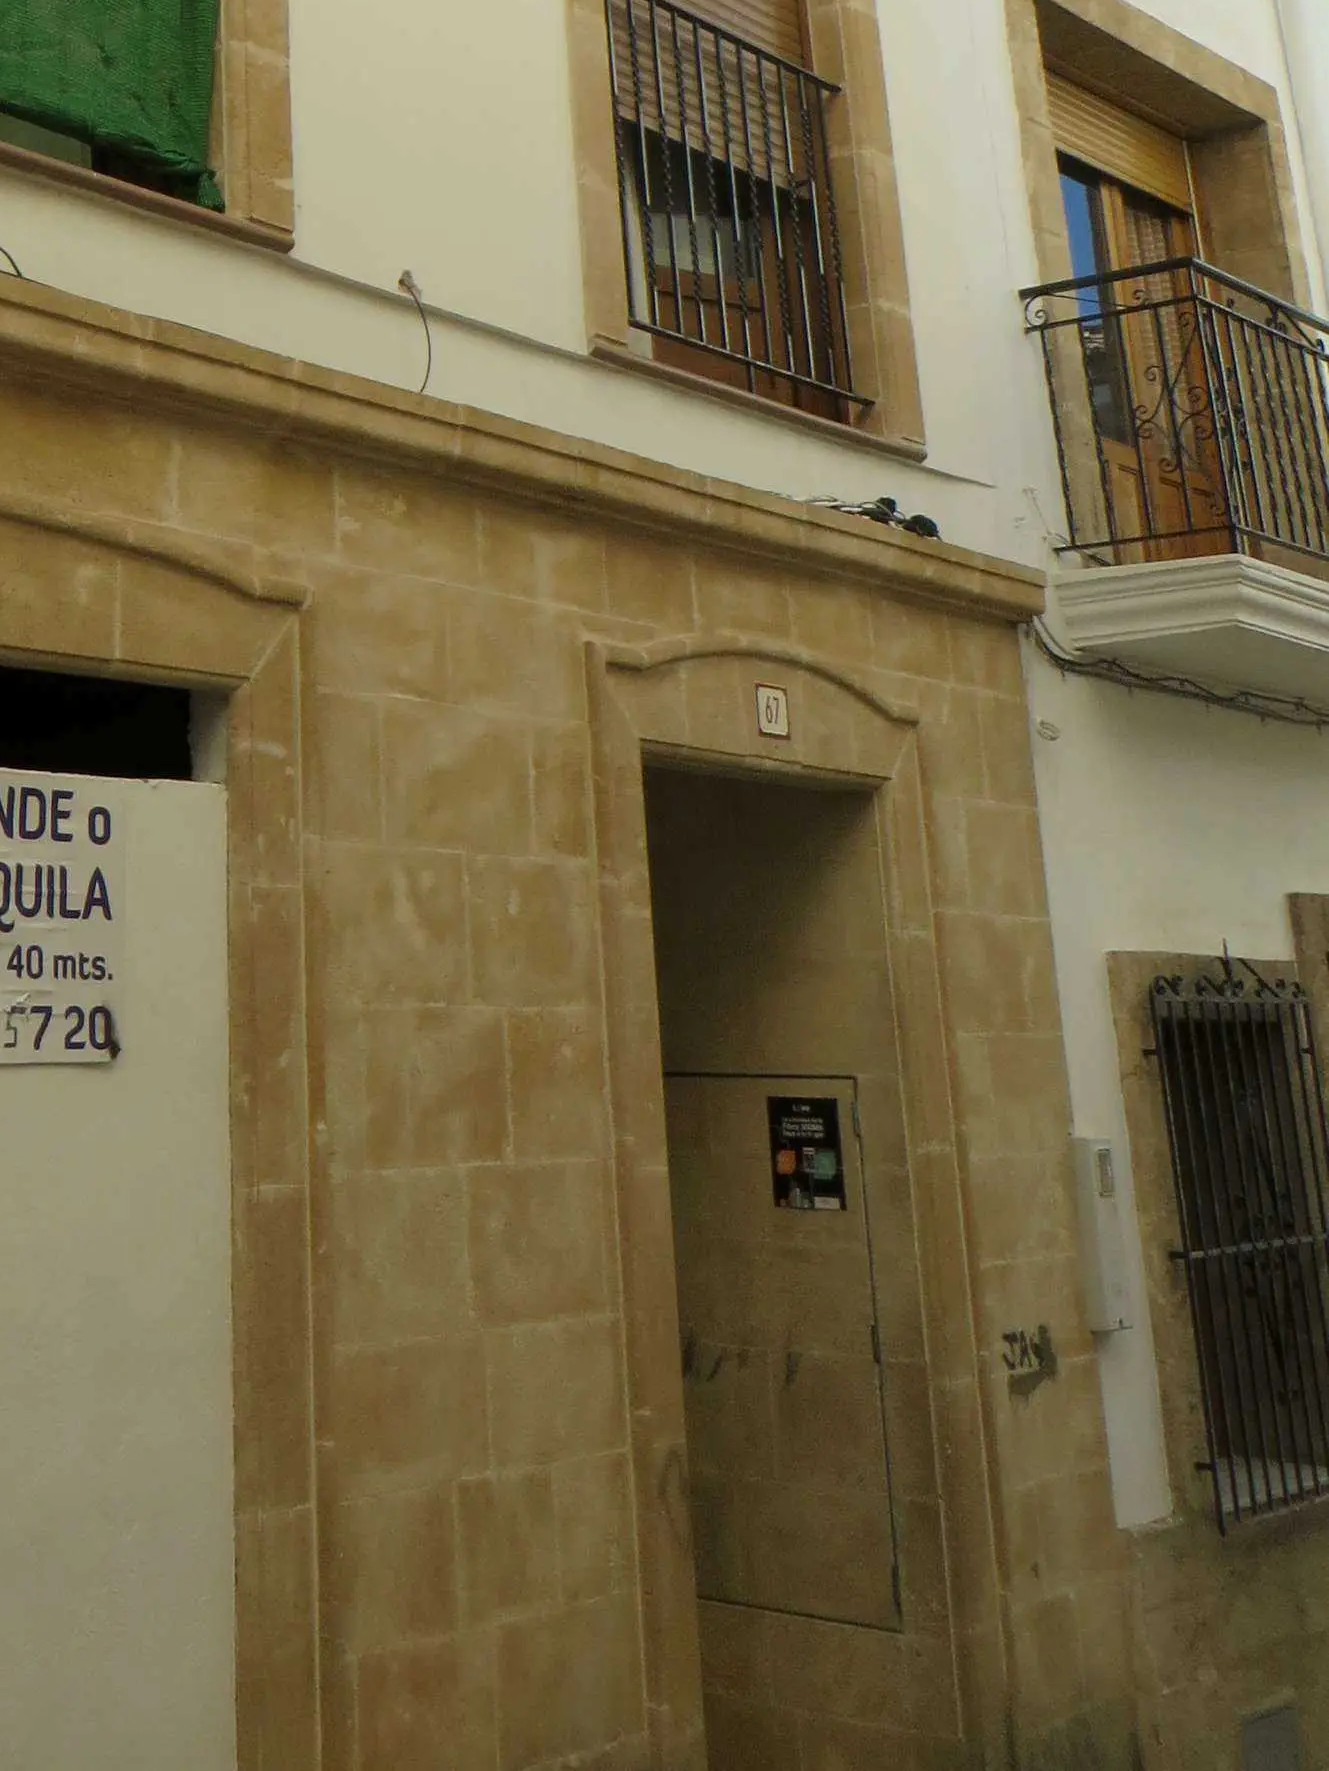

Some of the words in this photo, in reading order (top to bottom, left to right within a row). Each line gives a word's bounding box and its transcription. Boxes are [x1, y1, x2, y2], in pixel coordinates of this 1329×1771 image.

[765, 695, 779, 725] 67
[7, 944, 45, 979] 40
[53, 951, 114, 981] mts.
